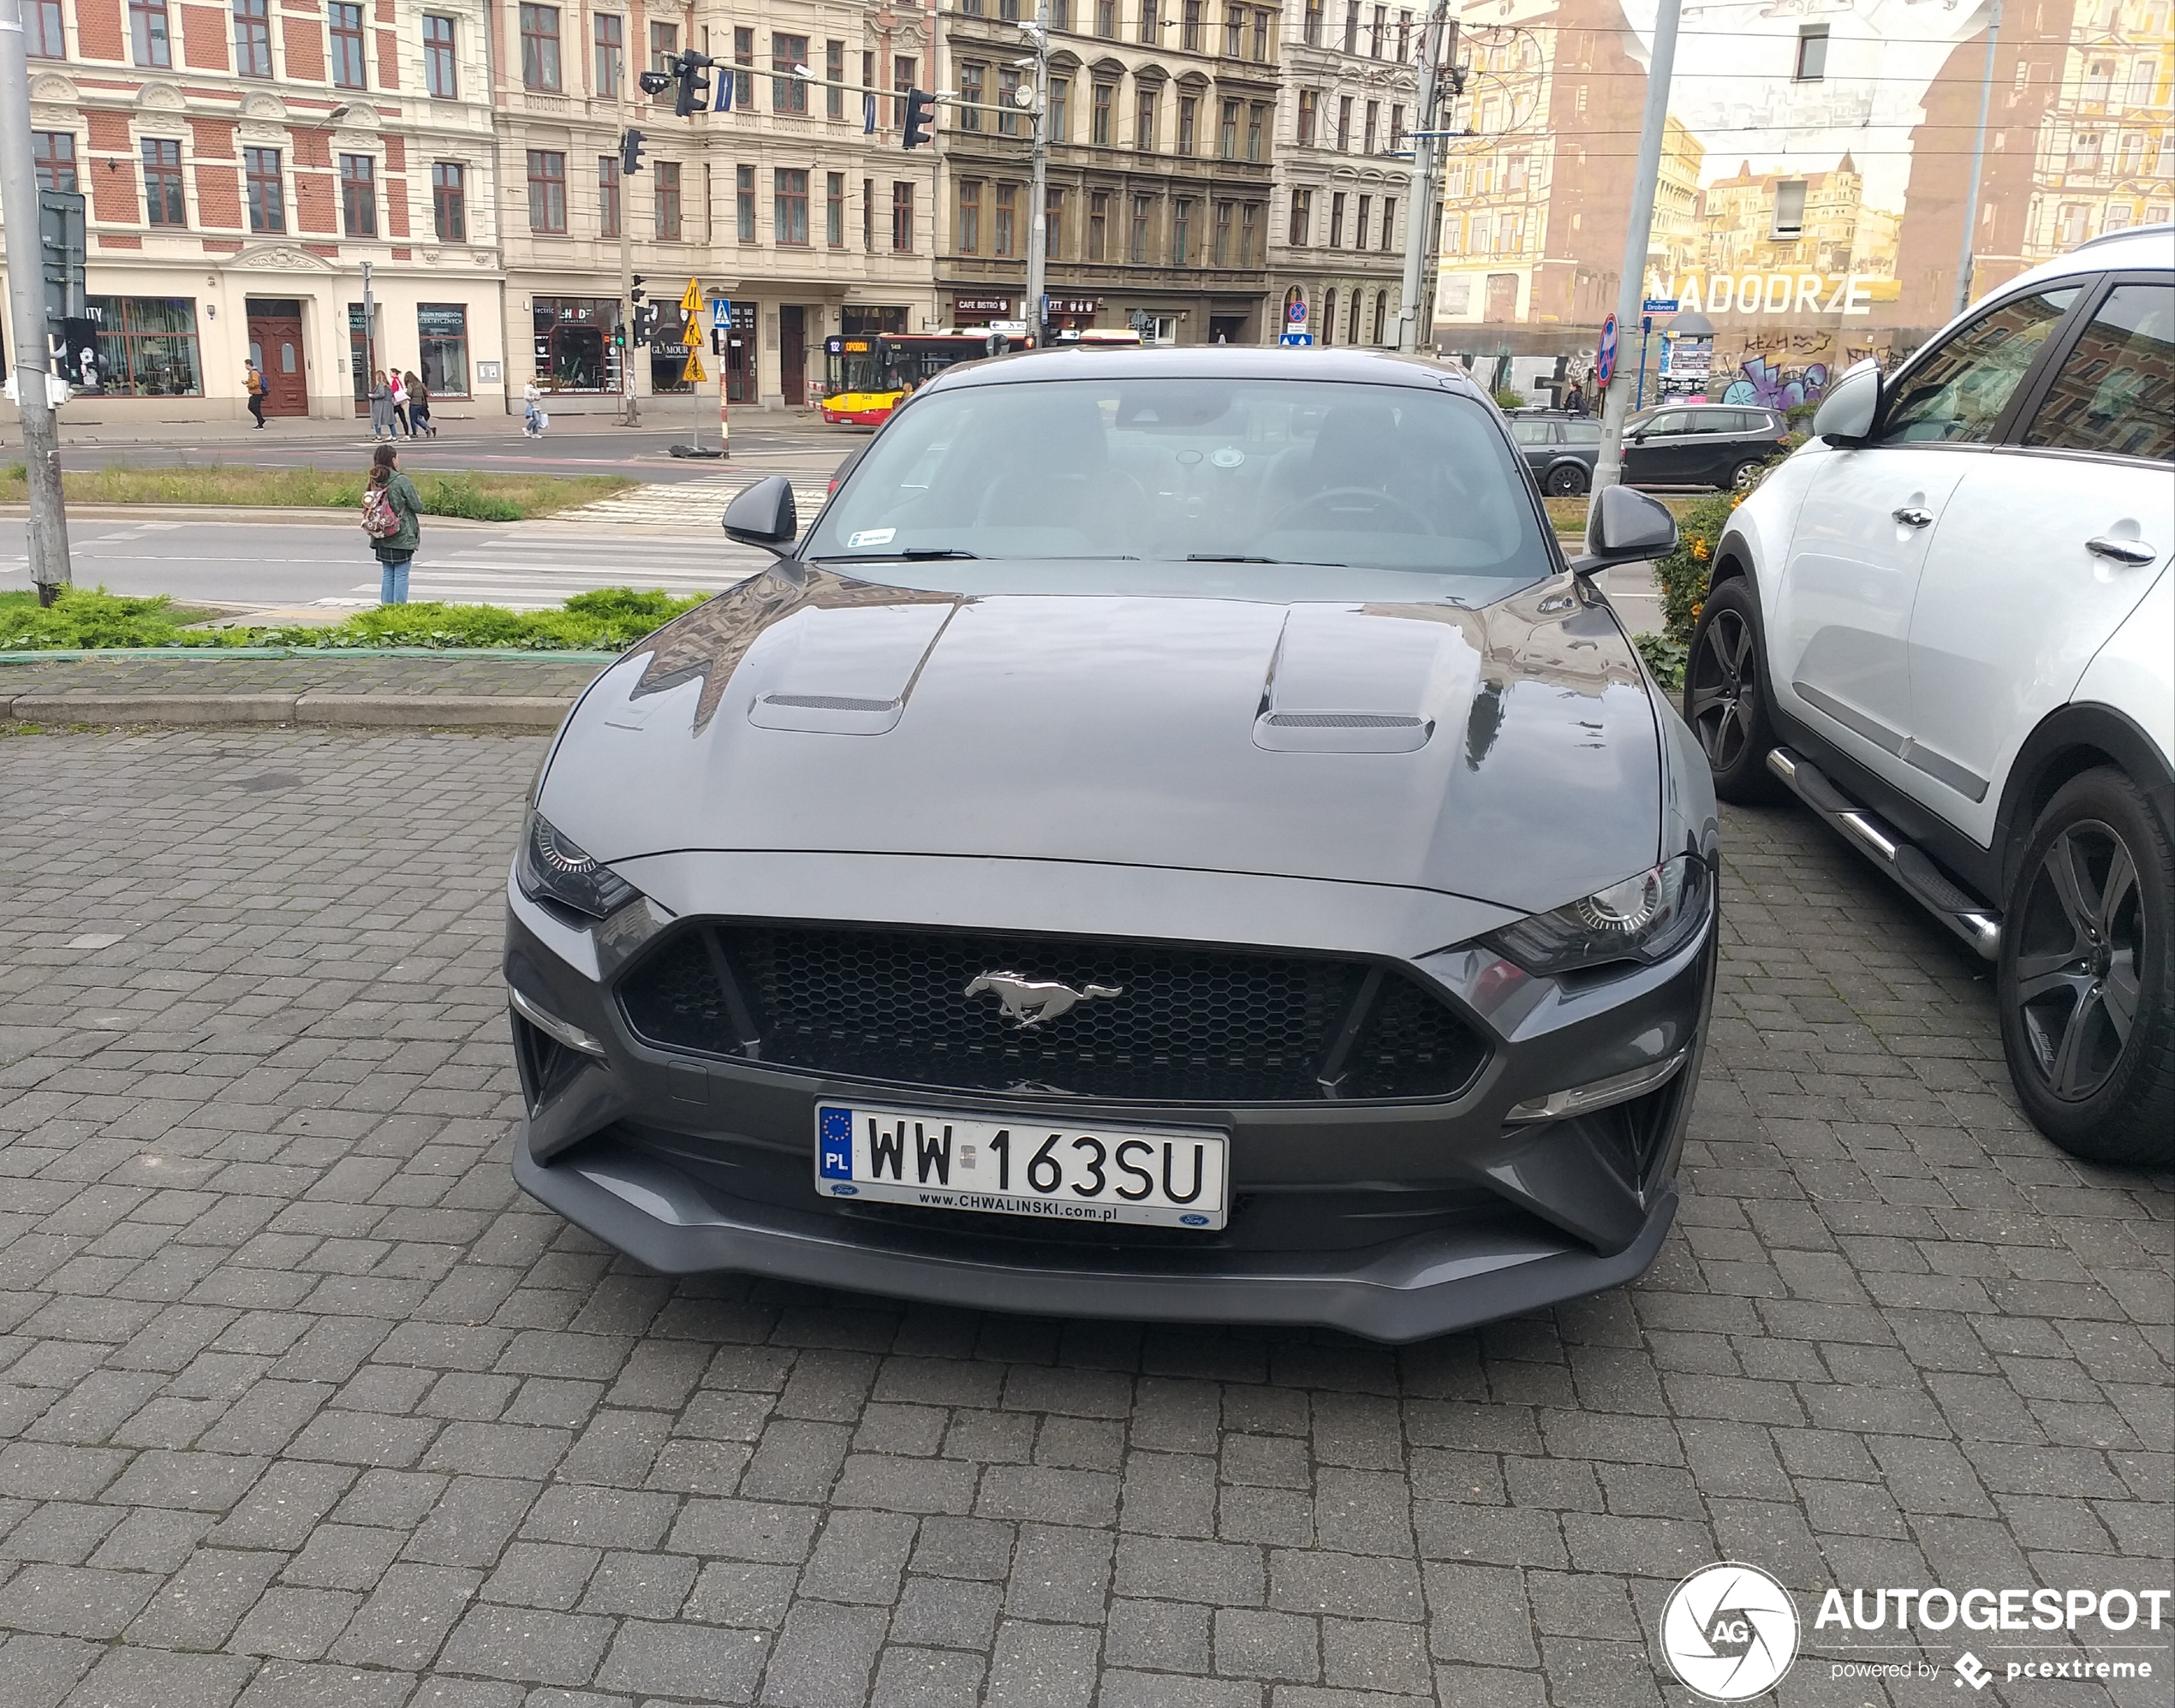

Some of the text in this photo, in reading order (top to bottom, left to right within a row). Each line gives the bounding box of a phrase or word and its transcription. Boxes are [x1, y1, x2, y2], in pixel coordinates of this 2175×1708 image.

[1651, 274, 1874, 315] NADODRZE
[959, 301, 998, 309] CAFE BISTRO
[86, 306, 102, 322] ITY
[564, 308, 587, 319] HND
[830, 341, 840, 352] 132
[825, 1152, 849, 1171] PL
[867, 1116, 1204, 1205] WW 163SU
[834, 1184, 855, 1194] Ford
[919, 1193, 1117, 1222] www.CHWALINSKI.com.pl
[1182, 1215, 1207, 1225] Ford
